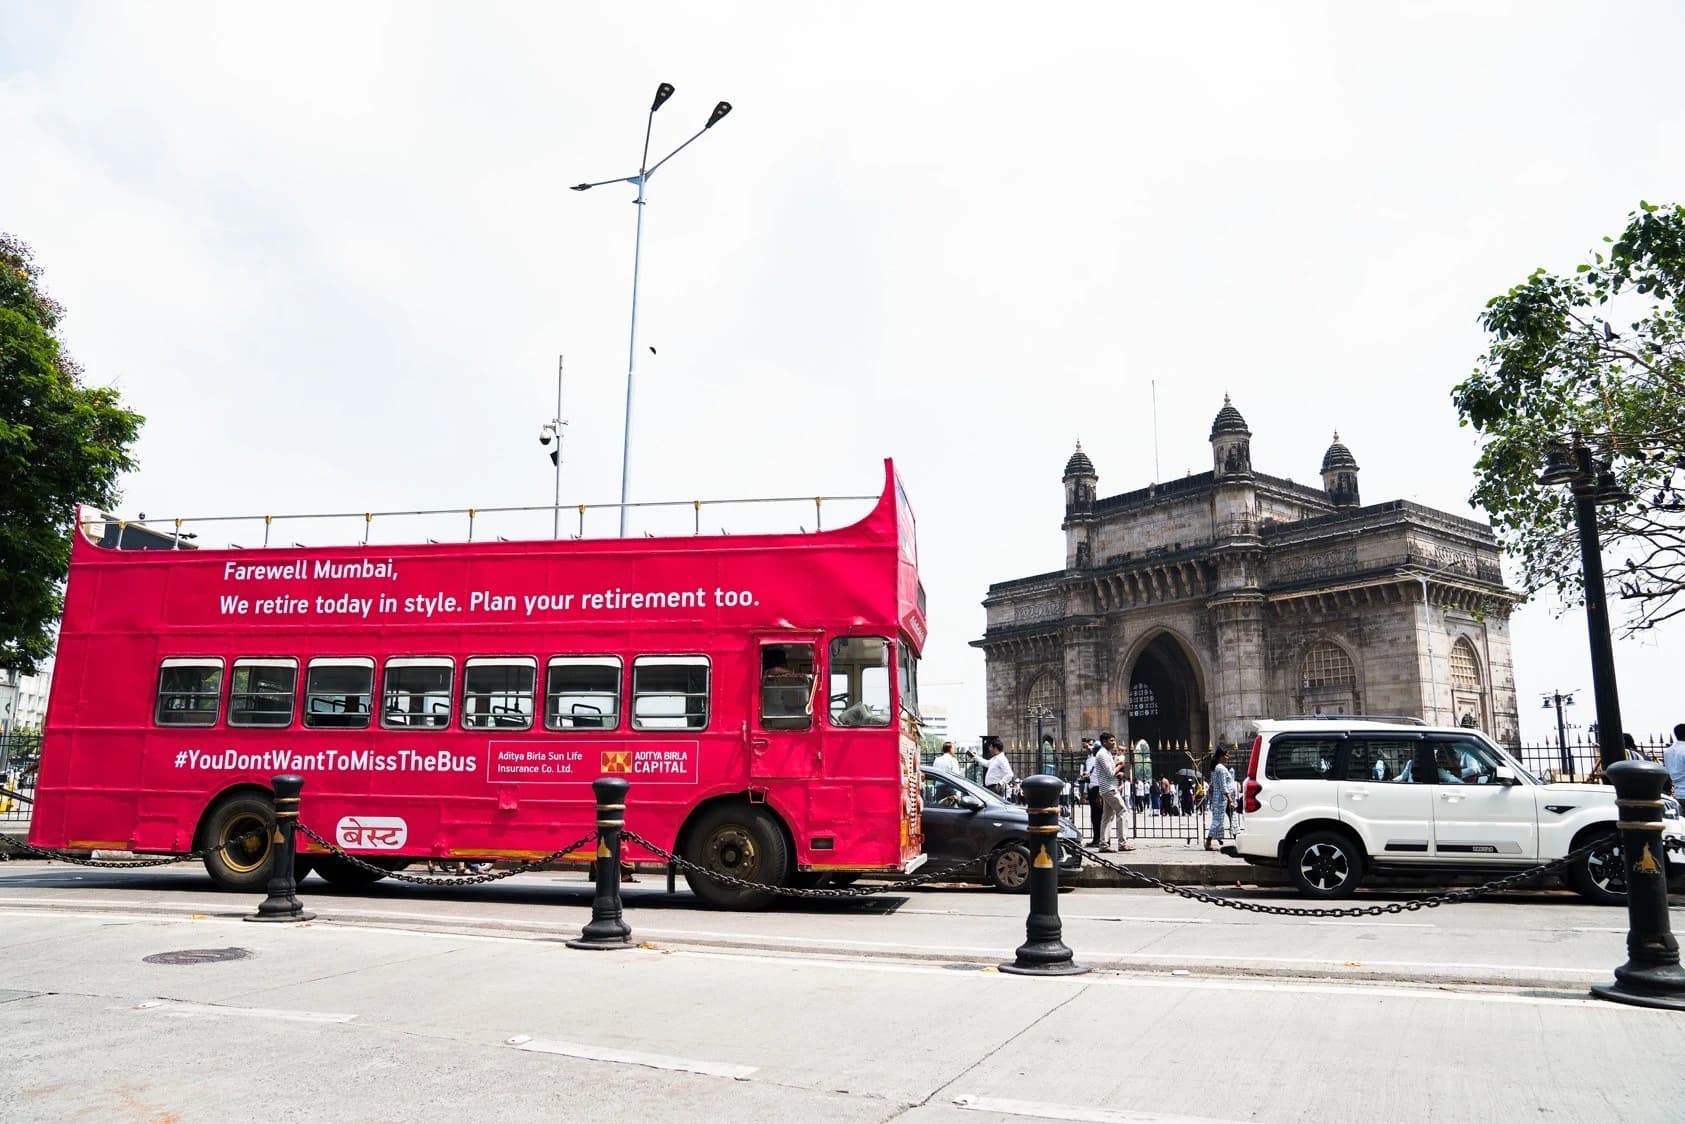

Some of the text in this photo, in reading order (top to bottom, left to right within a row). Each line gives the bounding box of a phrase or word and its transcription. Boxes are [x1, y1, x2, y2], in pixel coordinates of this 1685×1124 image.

[223, 559, 399, 580] Farewell Mumbai,
[220, 588, 759, 618] We retire today in style. Plan your retirement too.
[175, 750, 476, 771] #YouDontWantToMissTheBus
[499, 752, 582, 762] Aditya Birla Sun Life
[635, 752, 687, 761] ADITYA BIRLA
[498, 764, 573, 773] Insurance Co. Ltd.
[635, 761, 687, 773] CAPITAL
[341, 818, 402, 847] बेस्ट
